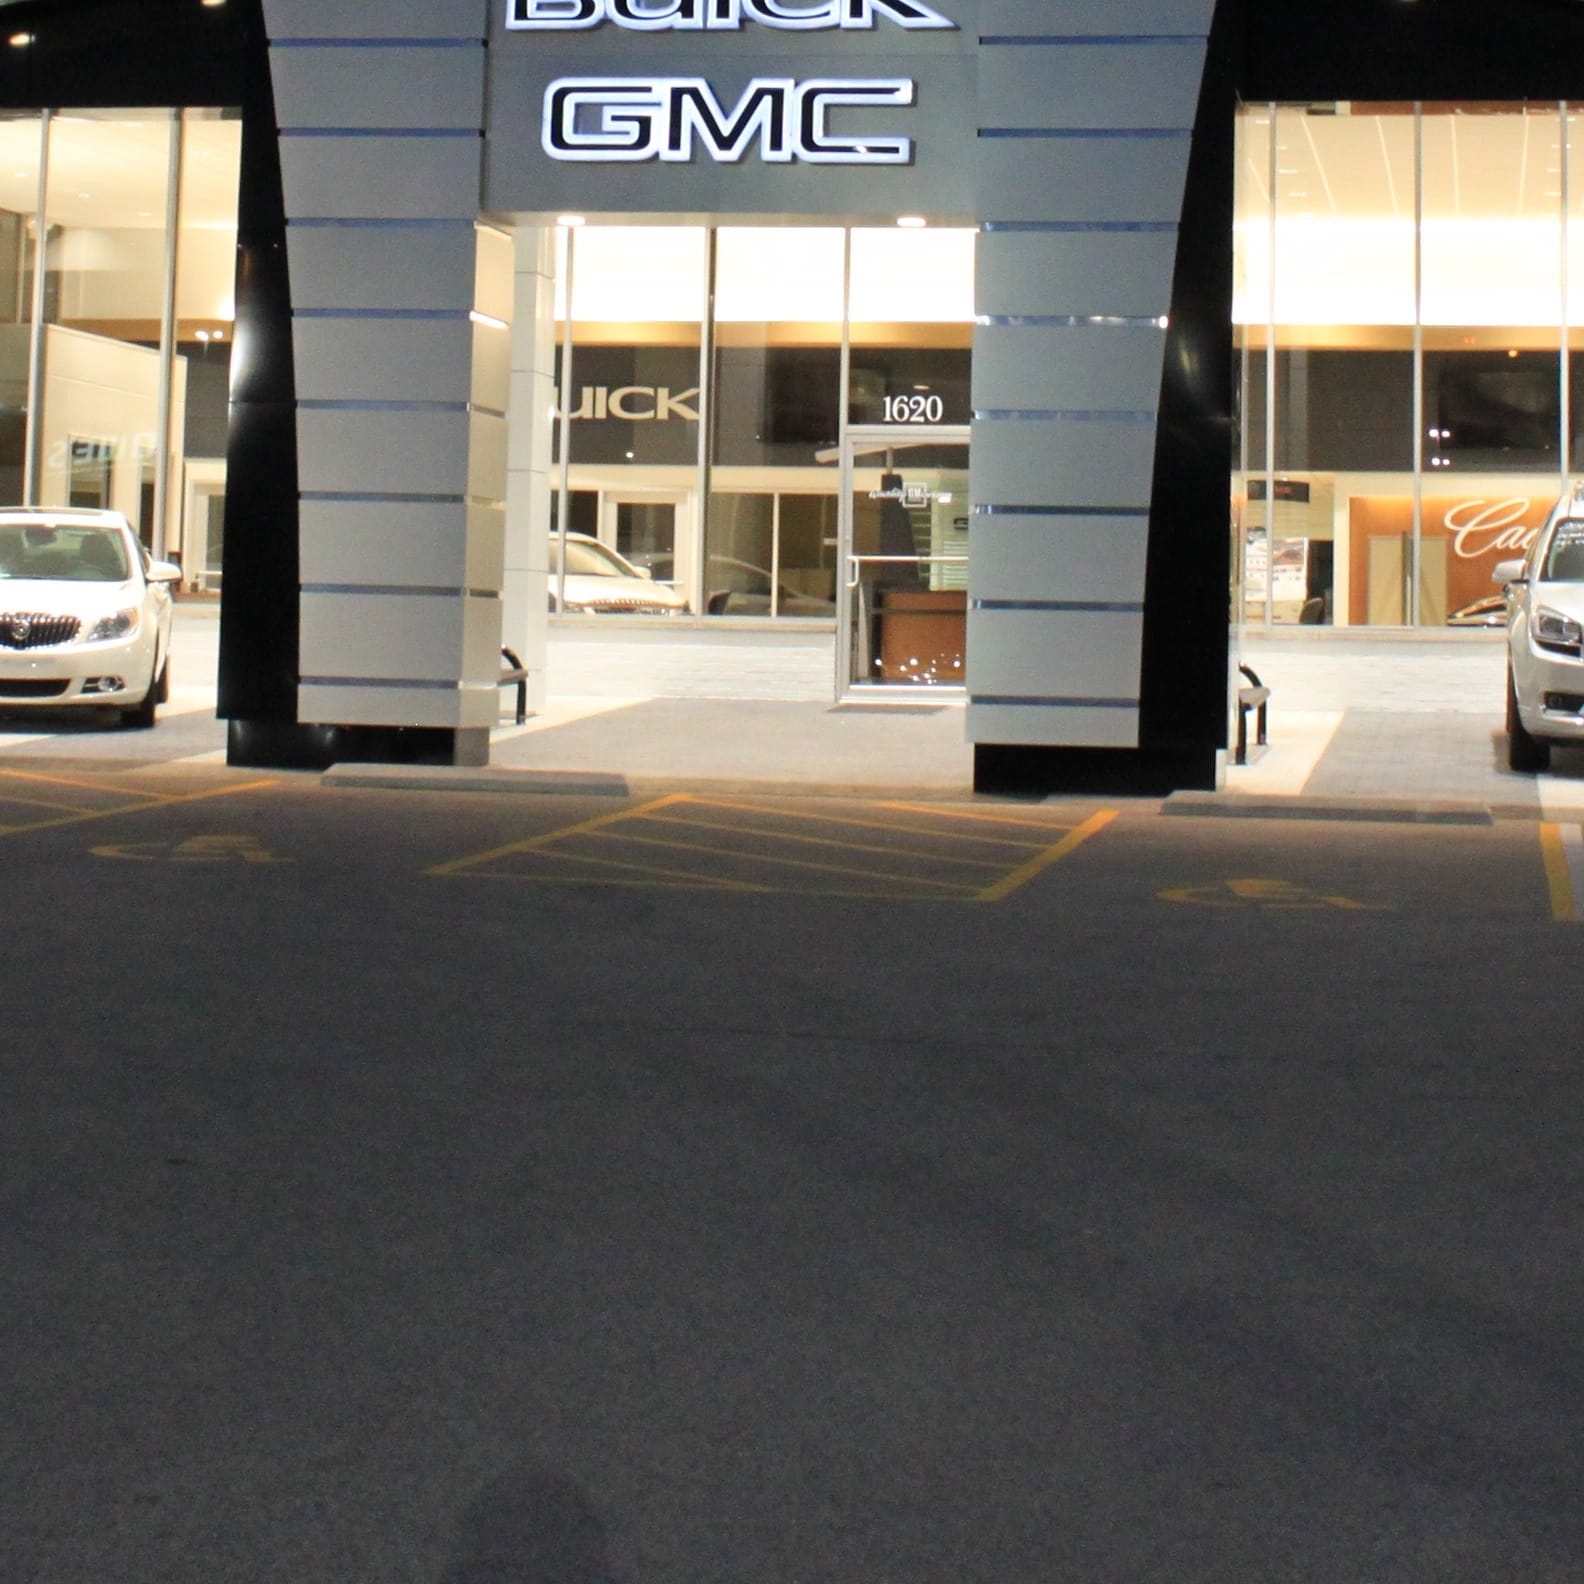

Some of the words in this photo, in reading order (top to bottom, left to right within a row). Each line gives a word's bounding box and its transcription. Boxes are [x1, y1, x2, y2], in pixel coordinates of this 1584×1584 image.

[540, 76, 914, 164] GMC
[554, 386, 700, 420] UICK
[882, 395, 943, 423] 1620
